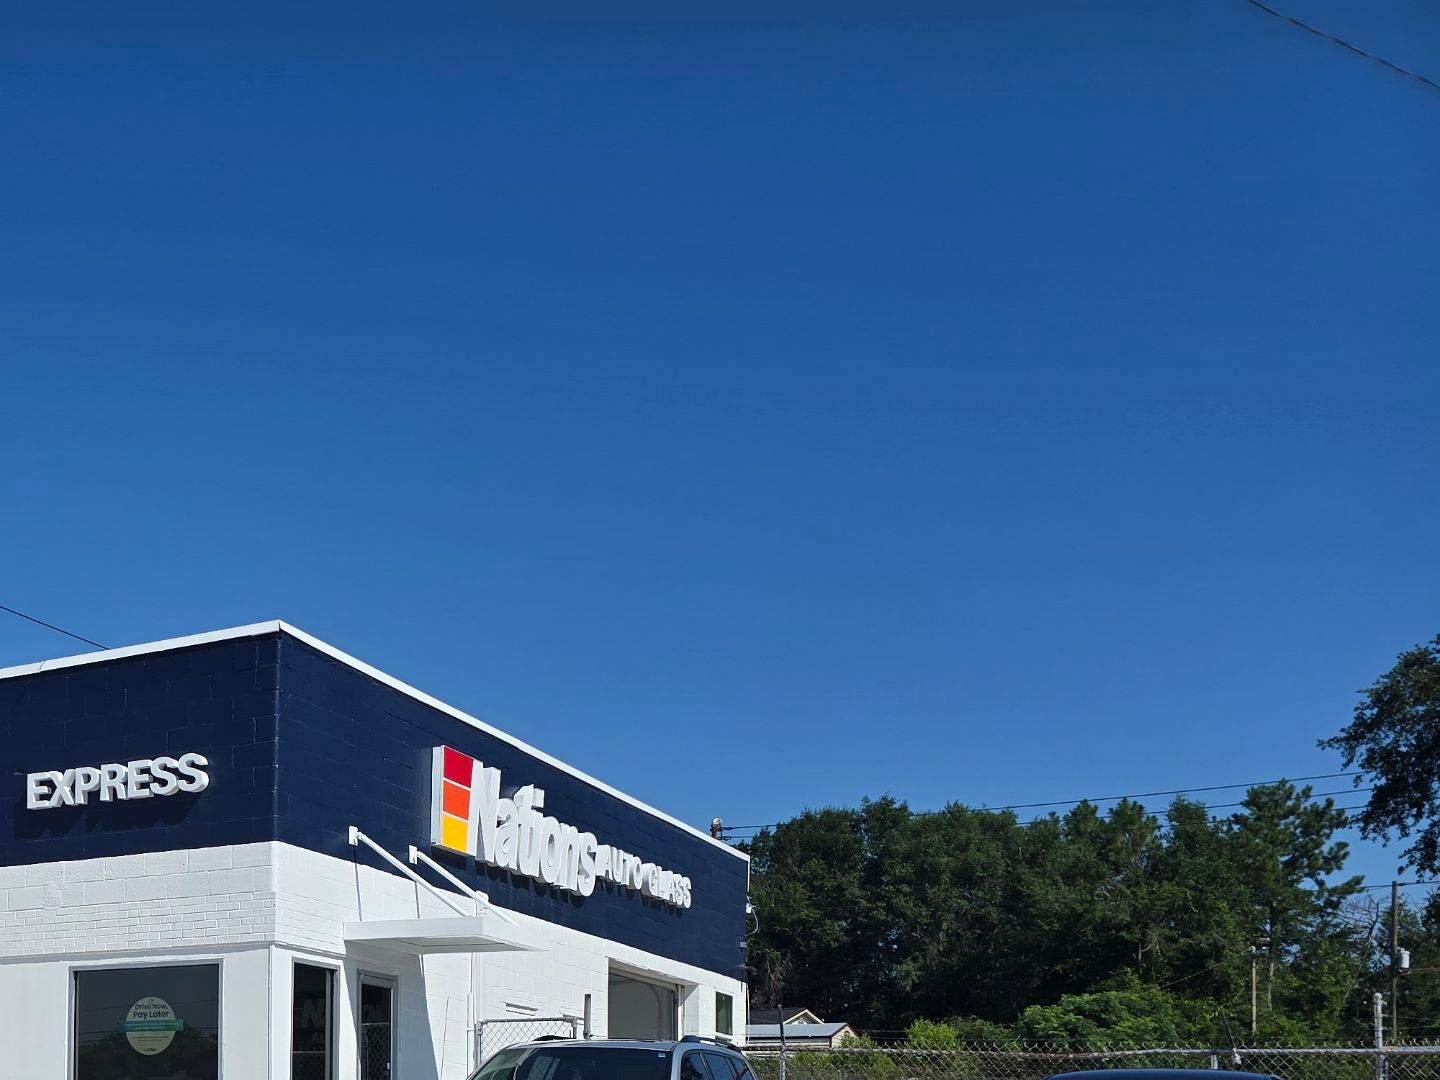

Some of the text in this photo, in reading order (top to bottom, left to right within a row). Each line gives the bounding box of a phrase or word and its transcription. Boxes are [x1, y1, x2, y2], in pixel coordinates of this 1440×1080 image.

[26, 752, 210, 810] EXPRESS
[468, 760, 692, 908] Nations AUTO GLASS
[133, 1010, 169, 1020] Pay Later
